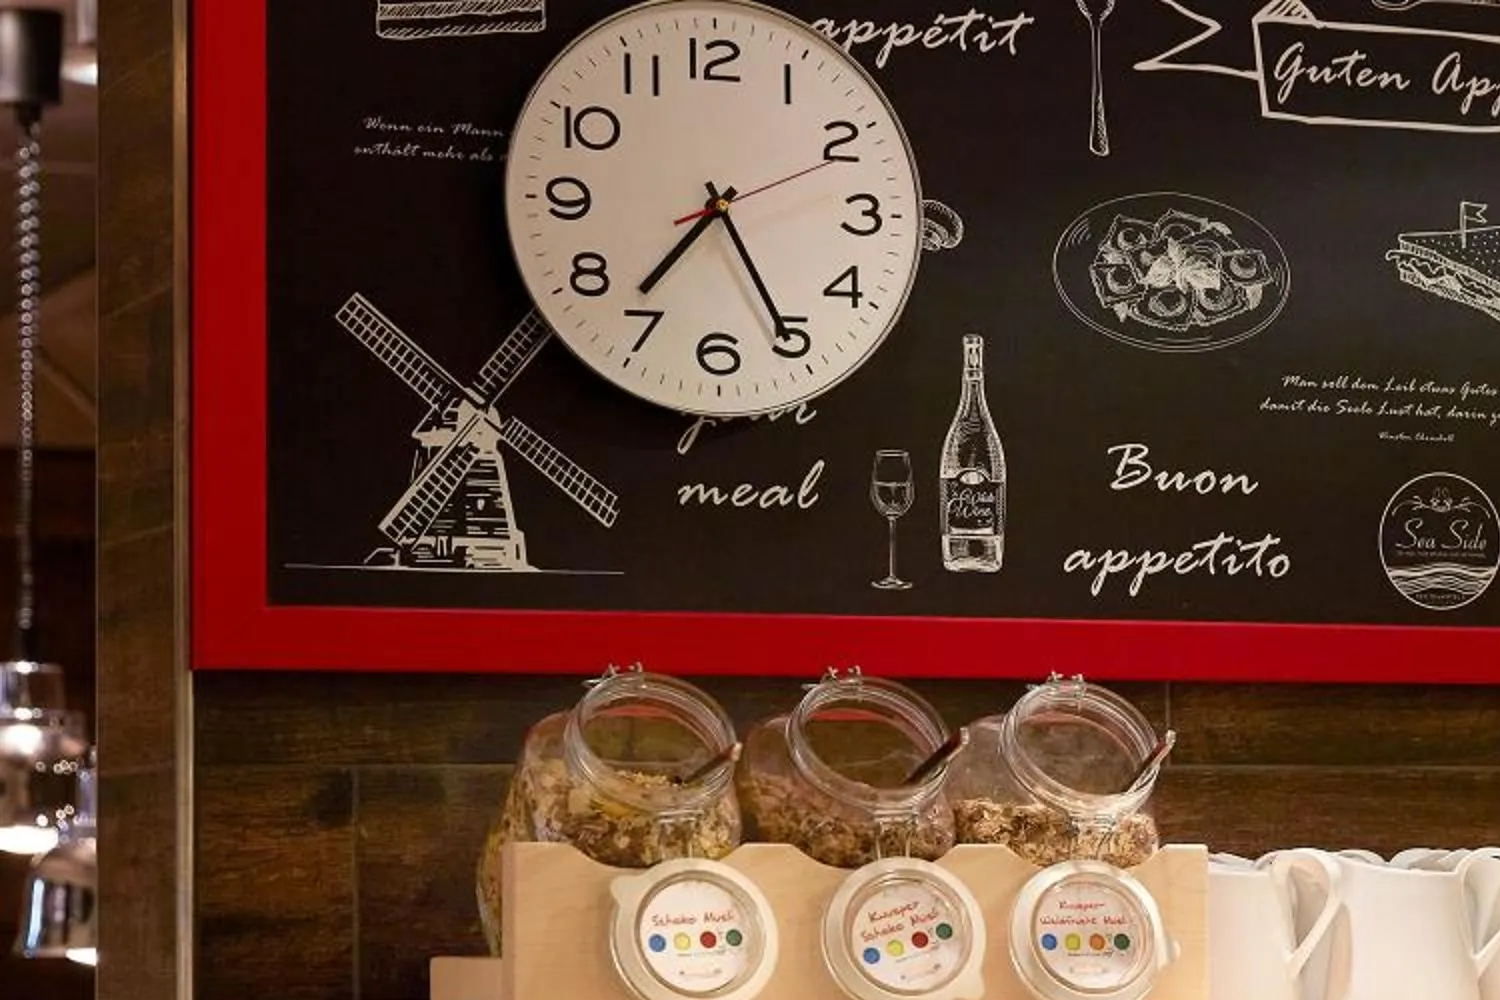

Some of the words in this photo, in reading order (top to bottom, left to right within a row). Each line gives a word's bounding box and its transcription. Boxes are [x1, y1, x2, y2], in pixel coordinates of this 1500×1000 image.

[689, 38, 741, 82] 12
[812, 8, 1035, 69] appétit
[624, 53, 659, 96] 11
[783, 64, 792, 104] 1
[1273, 42, 1410, 104] Guten
[565, 106, 621, 151] 10
[823, 121, 860, 163] 2
[545, 177, 591, 220] 9
[840, 194, 883, 236] 3
[570, 252, 610, 296] 8
[823, 265, 863, 309] 4
[624, 310, 664, 353] 7
[772, 317, 811, 358] 5
[696, 333, 742, 376] 6
[1259, 396, 1305, 412] damit
[1307, 398, 1331, 414] die
[1335, 399, 1373, 416] Seele
[1377, 401, 1414, 417] Lust
[1446, 404, 1488, 421] darin
[1280, 375, 1319, 389] Man
[1321, 375, 1349, 390] soll
[1351, 377, 1380, 392] dem
[1384, 376, 1415, 393] Leib
[1460, 381, 1498, 401] Gutes
[677, 459, 825, 510] meal
[1106, 443, 1259, 497] Buon
[1395, 517, 1437, 550] Sea
[1440, 519, 1488, 550] Side
[1063, 531, 1292, 597] appetito
